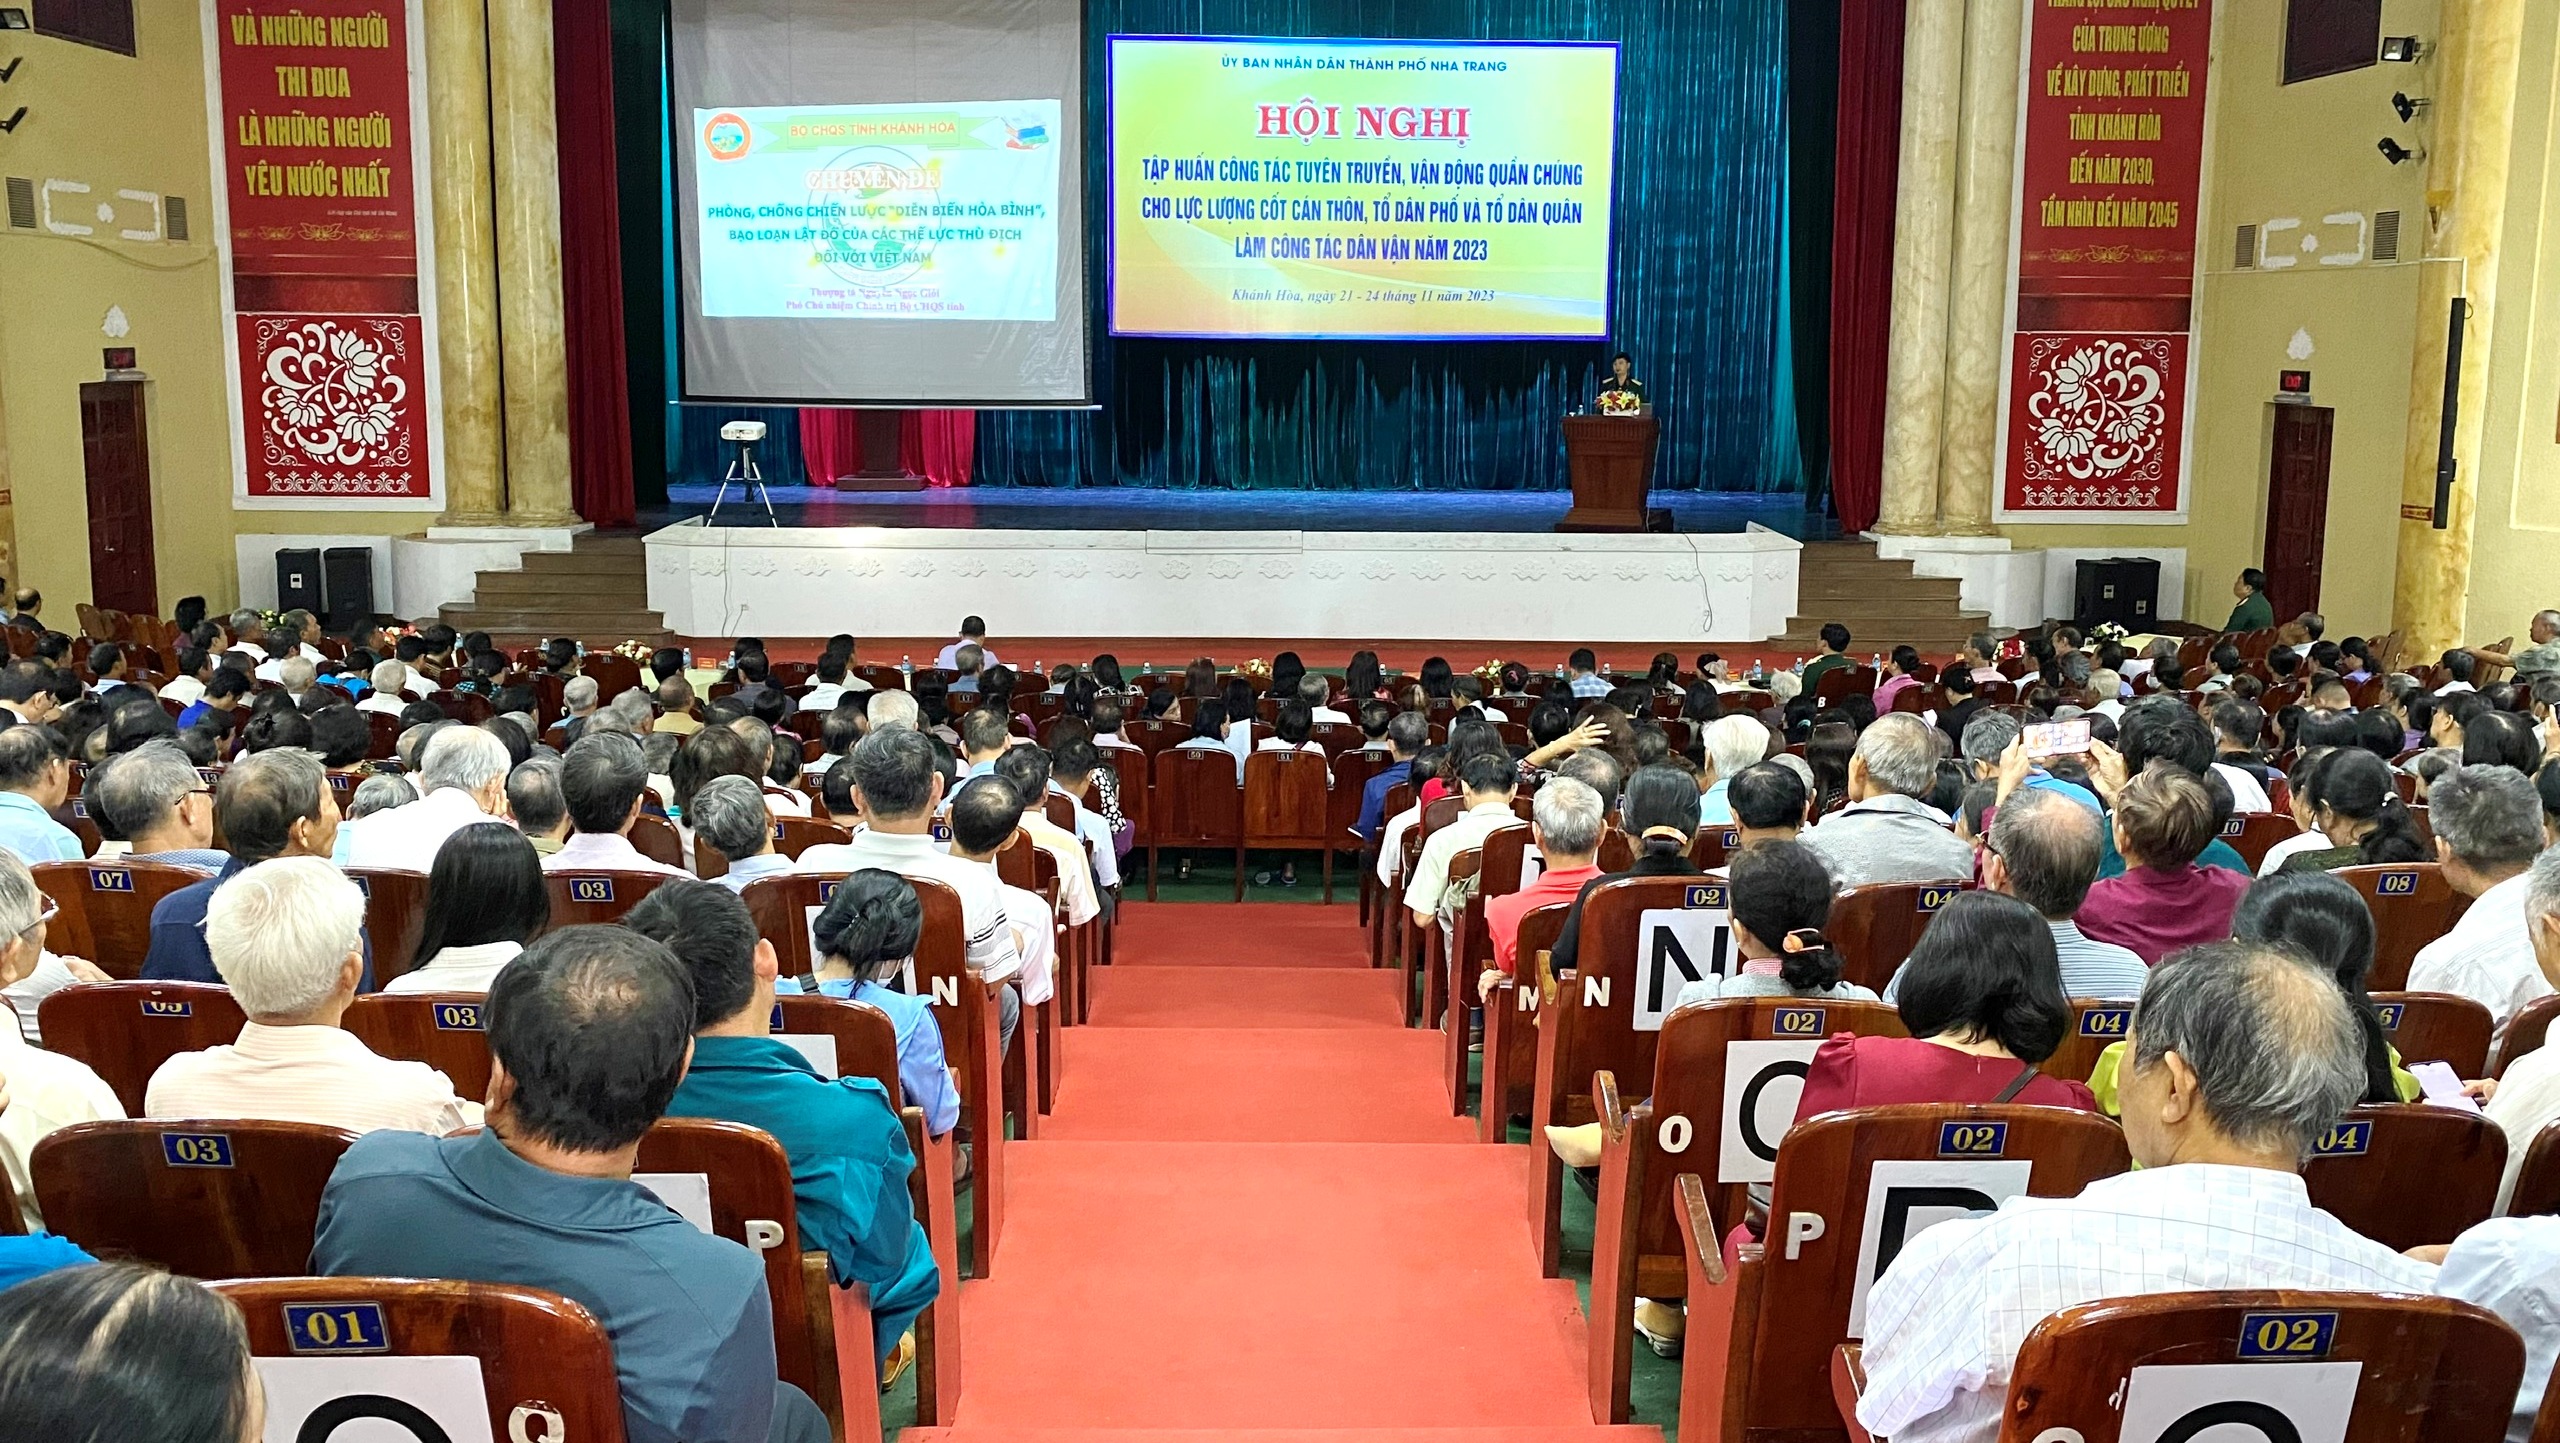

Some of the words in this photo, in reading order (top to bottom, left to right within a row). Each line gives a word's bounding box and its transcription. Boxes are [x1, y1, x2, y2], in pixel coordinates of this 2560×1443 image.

[231, 8, 258, 46] VÀ
[261, 9, 326, 47] NHỮNG
[330, 10, 388, 48] NGƯỜI
[2073, 17, 2096, 53] CỦA
[2099, 25, 2138, 53] TRUNG
[2138, 21, 2170, 53] ƯƠNG
[1222, 53, 1238, 68] ỦY
[1243, 57, 1270, 69] BAN
[1274, 56, 1312, 69] NHÂN
[1317, 56, 1345, 70] DÂN
[1350, 57, 1394, 71] THÀNH
[1399, 56, 1426, 71] PHỐ
[1431, 61, 1458, 71] NHA
[1463, 61, 1507, 72] TRANG
[275, 66, 308, 97] THI
[2047, 61, 2063, 97] VỀ
[2064, 65, 2087, 97] XÂY
[2124, 65, 2155, 97] PHÁT
[2156, 60, 2190, 97] TRIỂN
[239, 109, 261, 146] LÀ
[265, 109, 330, 147] NHỮNG
[334, 111, 391, 148] NGƯỜI
[812, 124, 845, 137] CHQS
[881, 121, 925, 135] KHÁNH
[929, 120, 956, 134] HÒA
[1257, 97, 1340, 145] HỘI
[1355, 105, 1471, 146] NGHỊ
[2070, 105, 2095, 140] TỈNH
[2098, 107, 2137, 141] KHÁNH
[2138, 108, 2161, 141] HÒA
[245, 160, 282, 196] YÊU
[287, 159, 337, 197] NƯỚC
[342, 158, 390, 198] NHẤT
[1142, 154, 1170, 186] TẬP
[1174, 151, 1215, 182] HUẤN
[1219, 155, 1259, 182] CÔNG
[1264, 155, 1291, 183] TÁC
[1296, 156, 1341, 184] TUYÊN
[1411, 158, 1440, 190] VẬN
[1444, 158, 1484, 190] ĐỘNG
[1533, 159, 1583, 187] CHÚNG
[2096, 152, 2121, 185] NĂM
[2122, 158, 2154, 187] 2030,
[707, 203, 755, 219] PHÒNG,
[968, 200, 996, 216] HÒA
[1142, 196, 1171, 219] CHO
[1176, 196, 1203, 223] LỰC
[1207, 196, 1255, 224] LƯỢNG
[1260, 192, 1287, 221] CỐT
[1292, 195, 1321, 222] CÁN
[1327, 195, 1368, 225] THÔN,
[1373, 192, 1391, 222] TỔ
[1395, 197, 1425, 223] DÂN
[1429, 194, 1459, 223] PHỐ
[1463, 197, 1481, 223] VÀ
[1486, 193, 1505, 223] TỔ
[1508, 198, 1538, 224] DÂN
[1542, 199, 1582, 226] QUÂN
[2067, 195, 2095, 227] NHÌN
[2121, 197, 2147, 228] NĂM
[2149, 201, 2178, 228] 2045
[728, 229, 754, 243] BẠO
[757, 229, 790, 243] LOẠN
[794, 226, 817, 243] LẬT
[842, 227, 868, 240] CỦA
[871, 226, 897, 240] CÁC
[928, 228, 954, 242] LỰC
[957, 226, 985, 240] THÙ
[988, 228, 1022, 242] ĐỊCH
[842, 248, 866, 264] VỚI
[869, 248, 900, 266] VIỆT
[903, 251, 932, 264] NAM
[1235, 231, 1266, 258] LÀM
[1271, 232, 1310, 259] CÔNG
[1315, 233, 1342, 259] TÁC
[1347, 233, 1376, 260] DÂN
[1381, 234, 1410, 265] VẬN
[1414, 235, 1448, 261] NĂM
[1453, 239, 1488, 261] 2023
[1232, 288, 1272, 301] Khánh
[1276, 288, 1304, 304] Hòa,
[1307, 291, 1337, 304] ngày
[1340, 290, 1353, 301] 21
[1365, 290, 1379, 301] 24
[1383, 289, 1417, 305] tháng
[1421, 289, 1433, 301] 11
[1436, 291, 1463, 302] năm
[1467, 289, 1495, 301] 2023
[1818, 697, 1826, 708] B
[203, 773, 217, 784] 13
[2222, 821, 2239, 834] 10
[98, 871, 124, 889] 07
[578, 882, 606, 898] 03
[2385, 875, 2411, 892] 08
[1694, 889, 1721, 905] 02
[1924, 890, 1952, 908] 04
[1647, 925, 1730, 1013] N
[932, 975, 958, 1006] N
[1518, 986, 1540, 1012] M
[1584, 976, 1611, 1007] N
[443, 1007, 477, 1026] 03
[1783, 1012, 1815, 1031] 02
[2090, 1012, 2121, 1032] 04
[176, 1141, 219, 1162] 03
[1952, 1127, 1993, 1152] 02
[2318, 1128, 2358, 1151] 04
[745, 1220, 785, 1260] P
[1785, 1211, 1826, 1260] P
[307, 1312, 368, 1346] 01
[2257, 1319, 2318, 1352] 02
